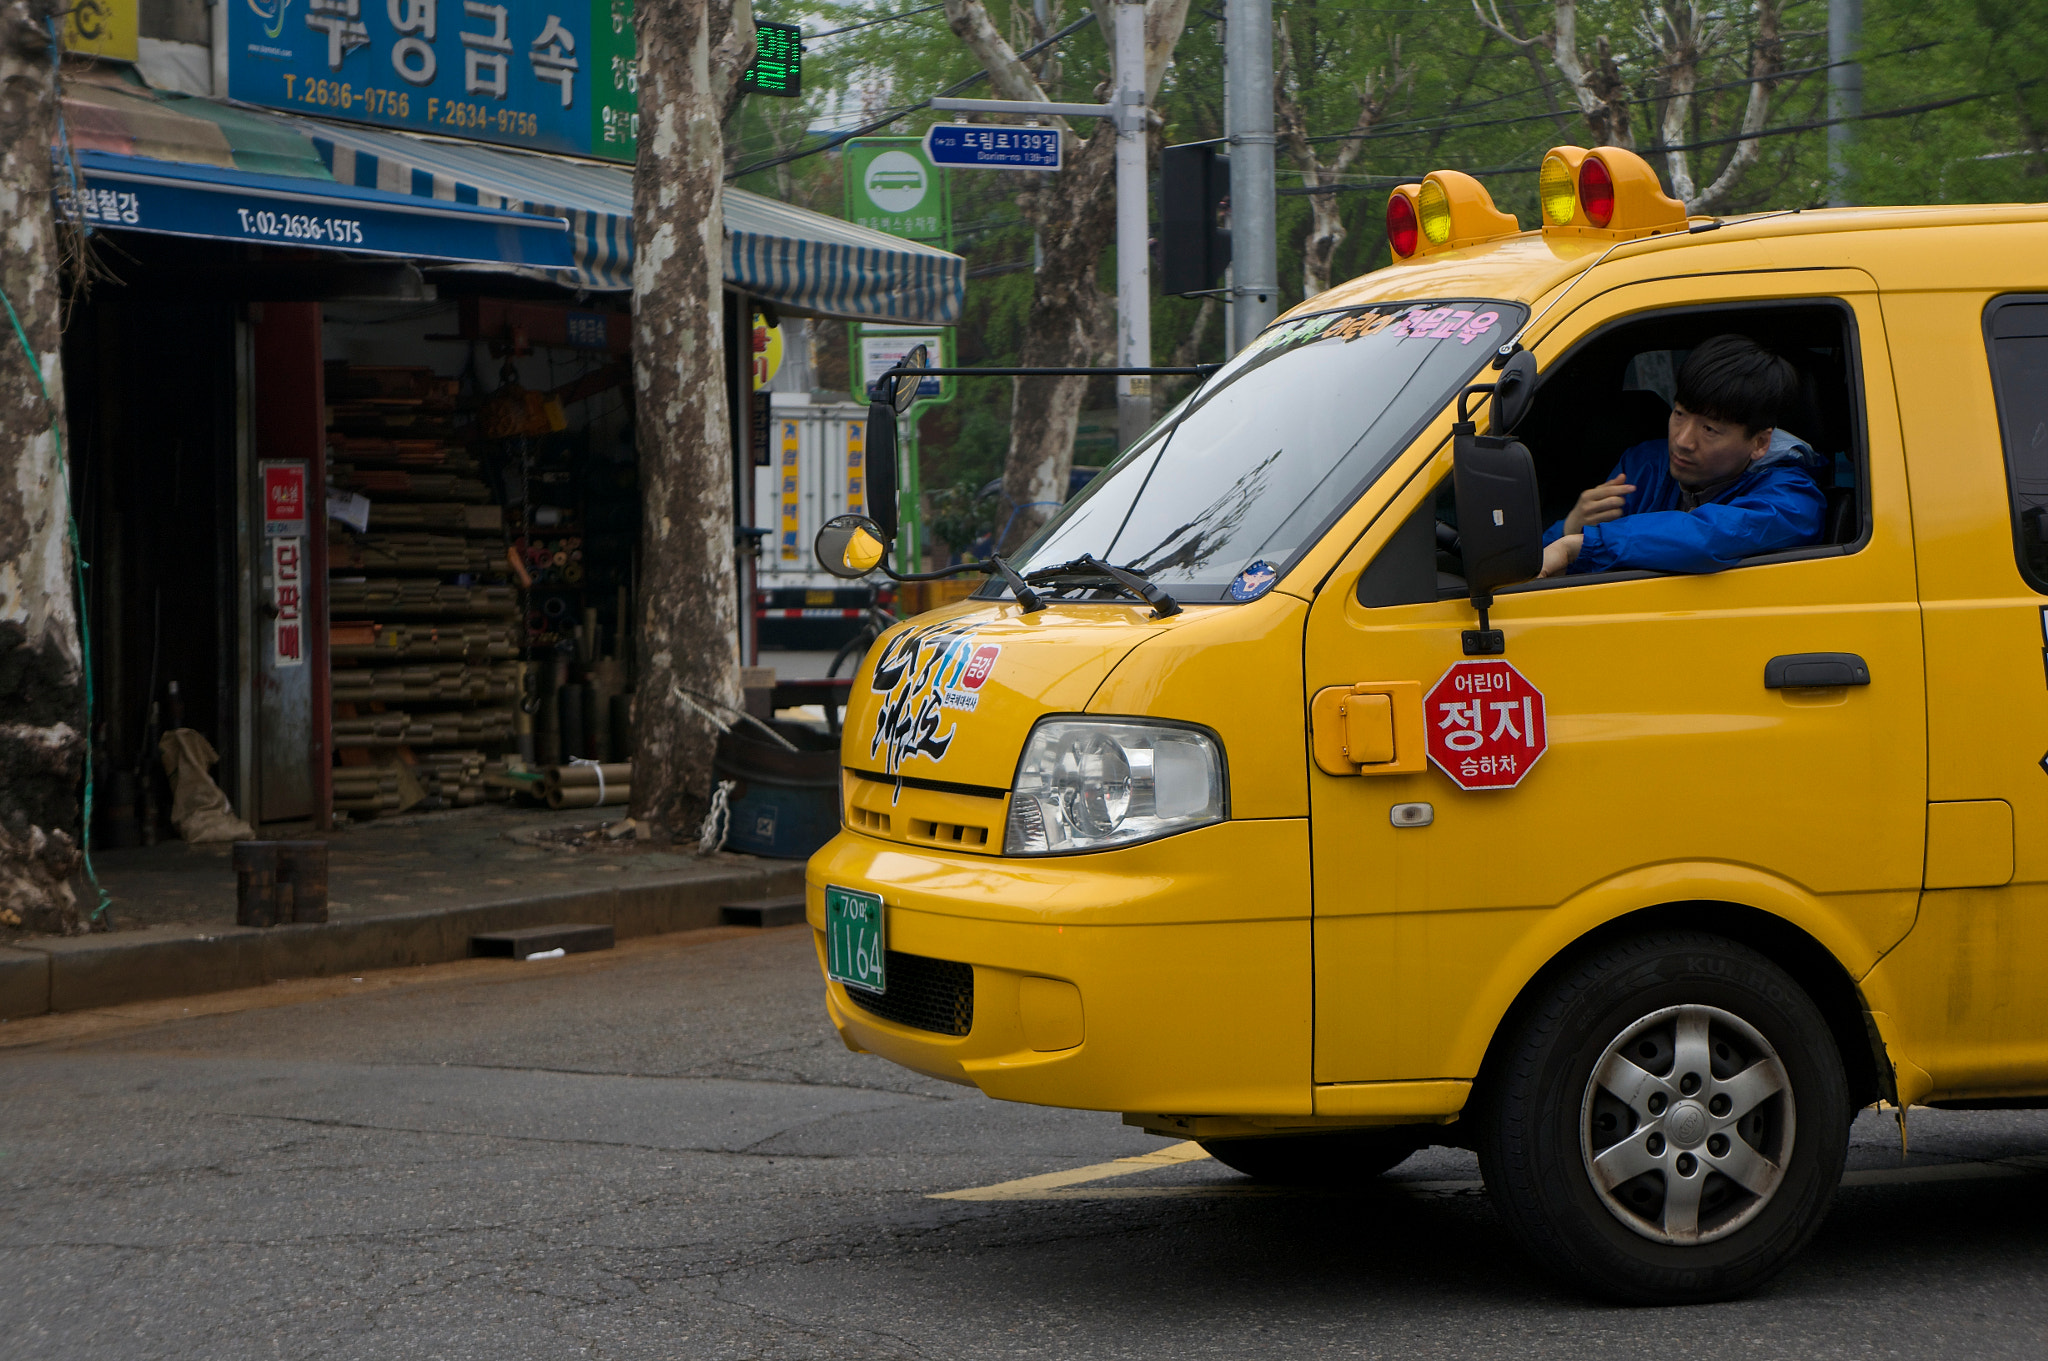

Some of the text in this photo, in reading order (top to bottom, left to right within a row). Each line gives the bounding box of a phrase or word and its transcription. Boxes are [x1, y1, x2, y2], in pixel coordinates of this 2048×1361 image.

[283, 74, 537, 137] T.2636-9756 F.2634-9756
[962, 132, 1057, 153] 도림로139길
[238, 208, 363, 244] T:02-2636-1575
[967, 656, 992, 679] 금강
[1455, 672, 1511, 693] 어린이
[1438, 696, 1535, 752] 정지
[1460, 754, 1517, 777] 승하차
[833, 921, 882, 984] 1164
